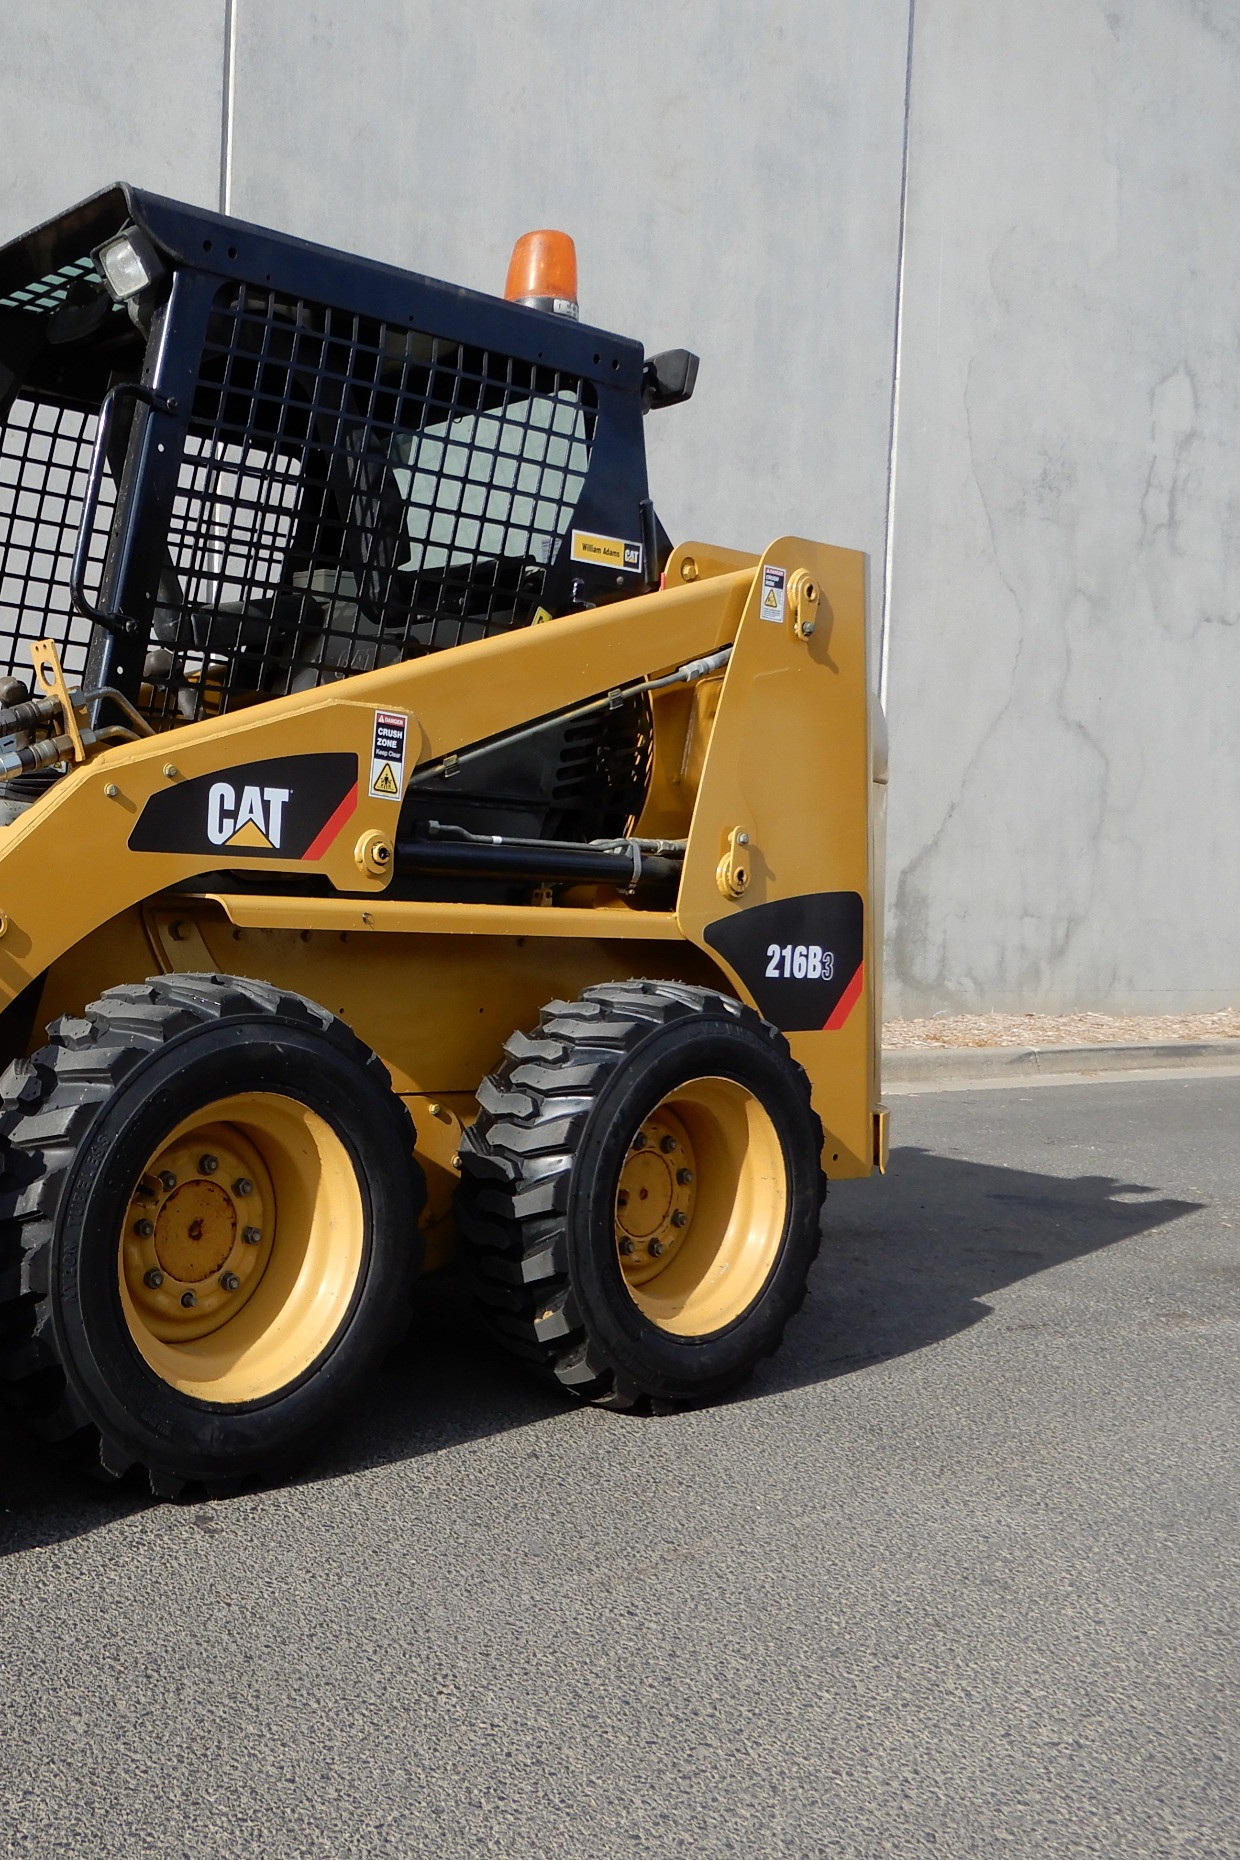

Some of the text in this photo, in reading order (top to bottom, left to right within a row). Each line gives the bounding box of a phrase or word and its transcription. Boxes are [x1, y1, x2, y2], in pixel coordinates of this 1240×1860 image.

[581, 542, 620, 558] William Adams
[624, 549, 639, 563] CAT
[384, 717, 404, 725] DANGER
[377, 727, 403, 739] CRUSH
[376, 738, 398, 748] ZONE
[375, 748, 401, 759] Keep Clear
[207, 782, 290, 849] CAT
